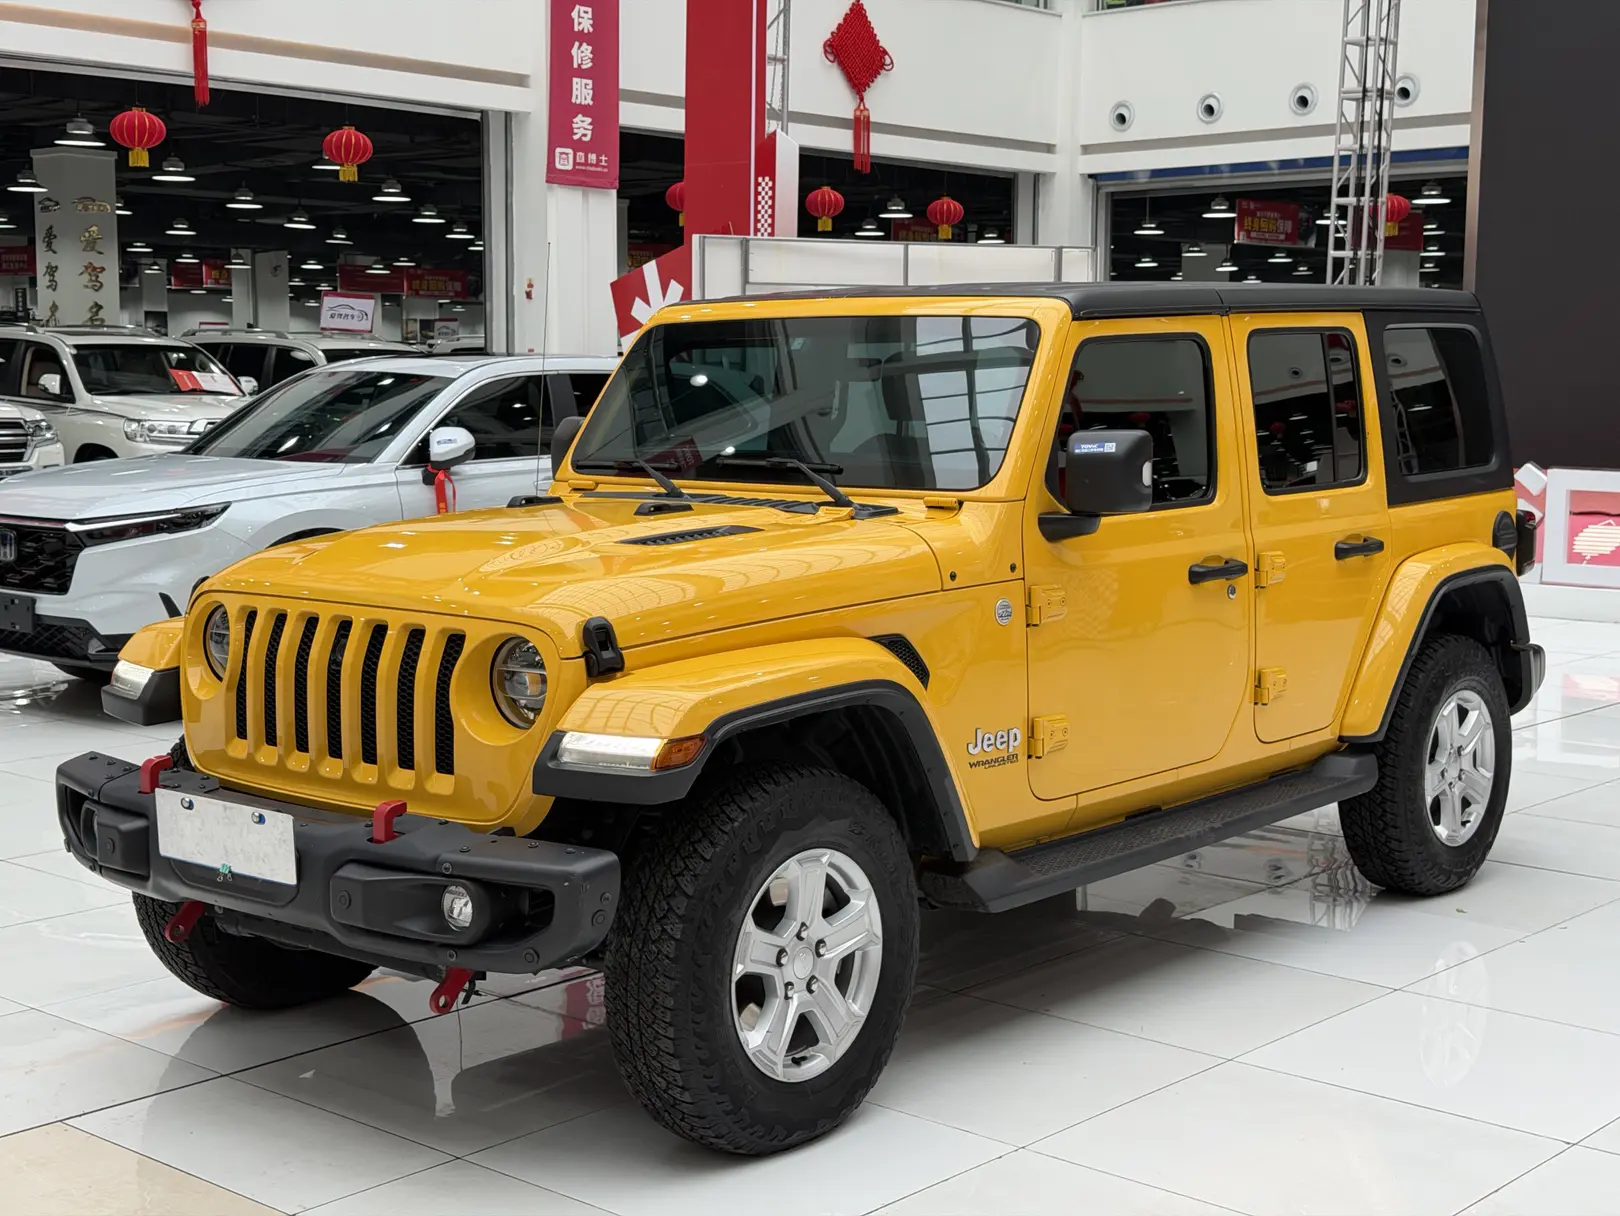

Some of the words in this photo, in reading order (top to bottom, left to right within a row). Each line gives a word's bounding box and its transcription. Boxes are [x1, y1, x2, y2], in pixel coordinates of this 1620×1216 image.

[571, 4, 593, 141] 保修服务
[967, 727, 1020, 755] Jeep
[968, 753, 1018, 769] WRANGLER
